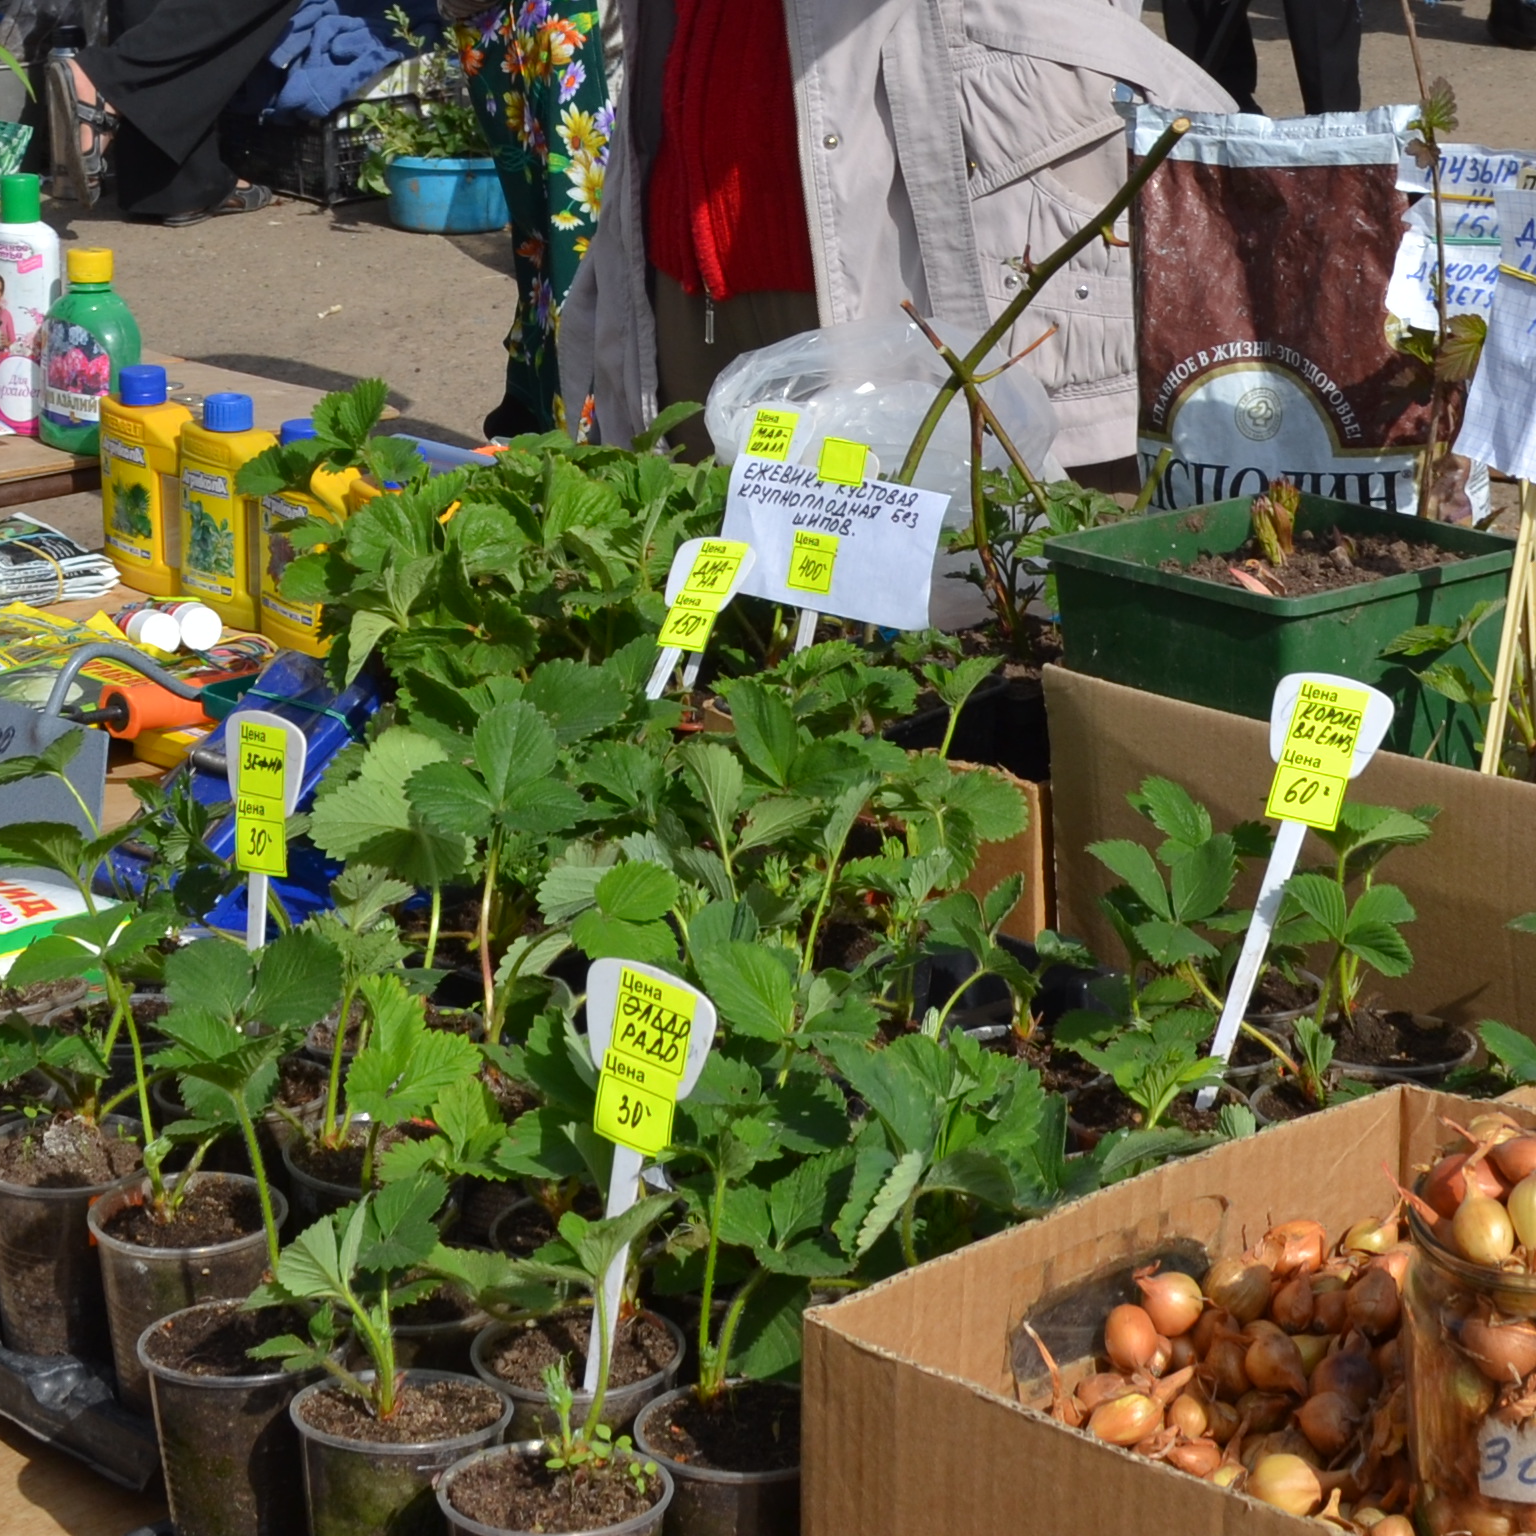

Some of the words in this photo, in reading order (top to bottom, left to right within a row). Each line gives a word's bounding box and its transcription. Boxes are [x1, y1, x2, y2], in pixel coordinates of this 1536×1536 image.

[1151, 355, 1198, 427] ГЛАВНОЕ
[1197, 350, 1211, 368] В
[1300, 357, 1363, 441] ЗДОРОВЬЕ!
[756, 411, 780, 424] Цена
[743, 462, 824, 490] ЕЖЕВИКА
[835, 478, 920, 508] КУСТОВАЯ
[737, 482, 882, 520] КРУПНОПЛОДНАЯ
[700, 541, 727, 555] Цена
[795, 531, 821, 547] Цена
[675, 593, 702, 607] Цена
[1301, 683, 1339, 702] Цена
[240, 724, 266, 742] Цена
[1283, 748, 1322, 769] Цена
[238, 798, 265, 816] Цена
[622, 970, 663, 1002] Цена
[605, 1052, 646, 1084] Цена
